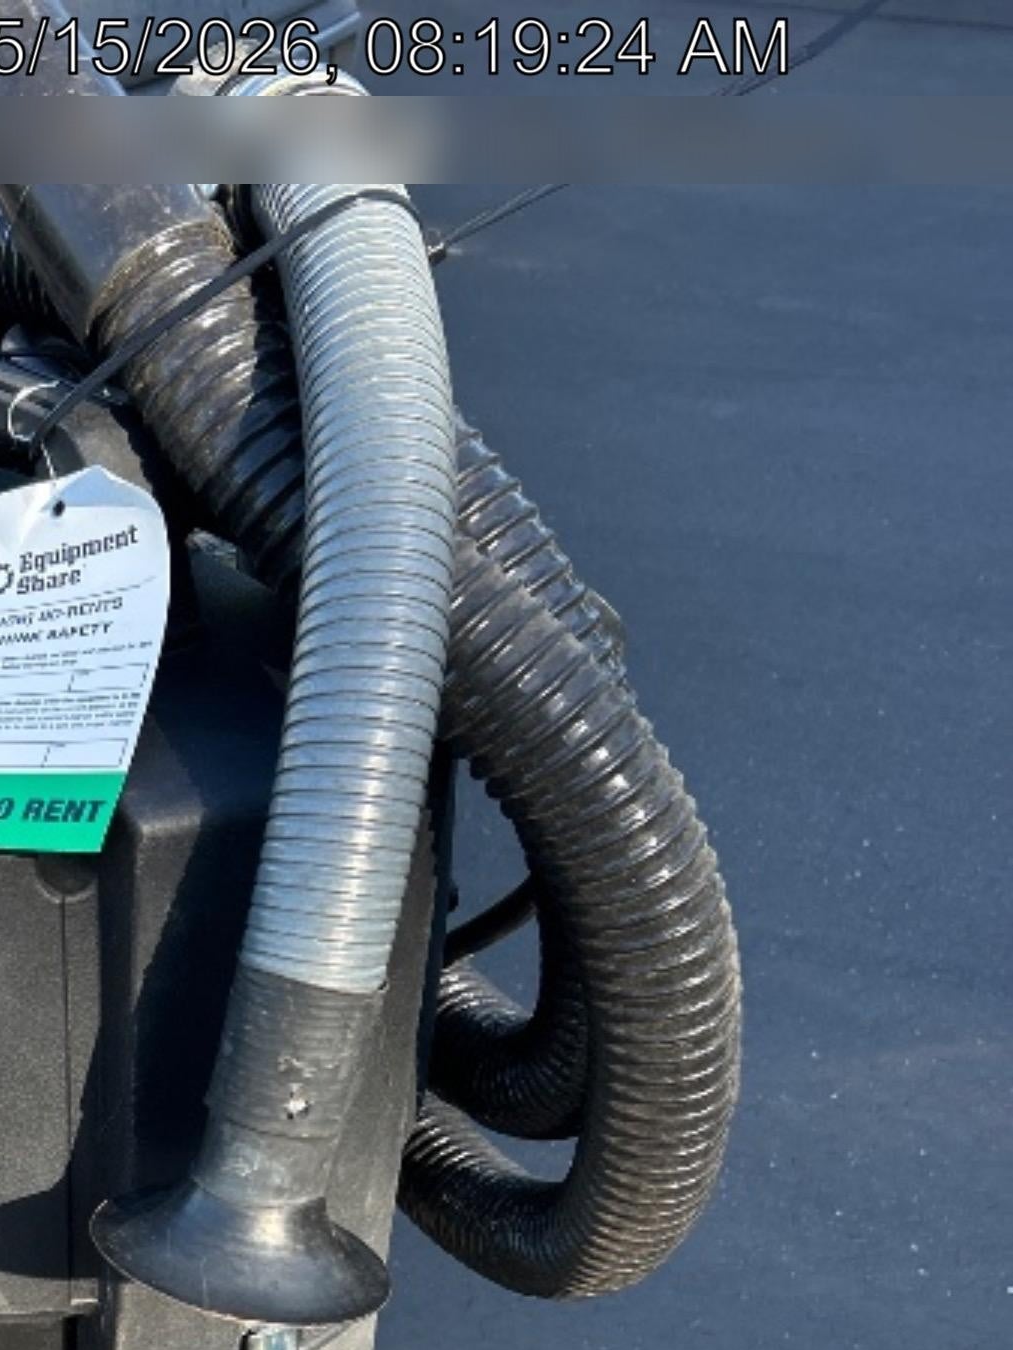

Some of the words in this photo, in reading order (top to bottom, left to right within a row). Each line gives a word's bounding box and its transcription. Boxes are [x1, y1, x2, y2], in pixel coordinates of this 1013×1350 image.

[19, 524, 138, 573] Equipment
[17, 569, 81, 595] Share
[22, 799, 107, 824] RENT
